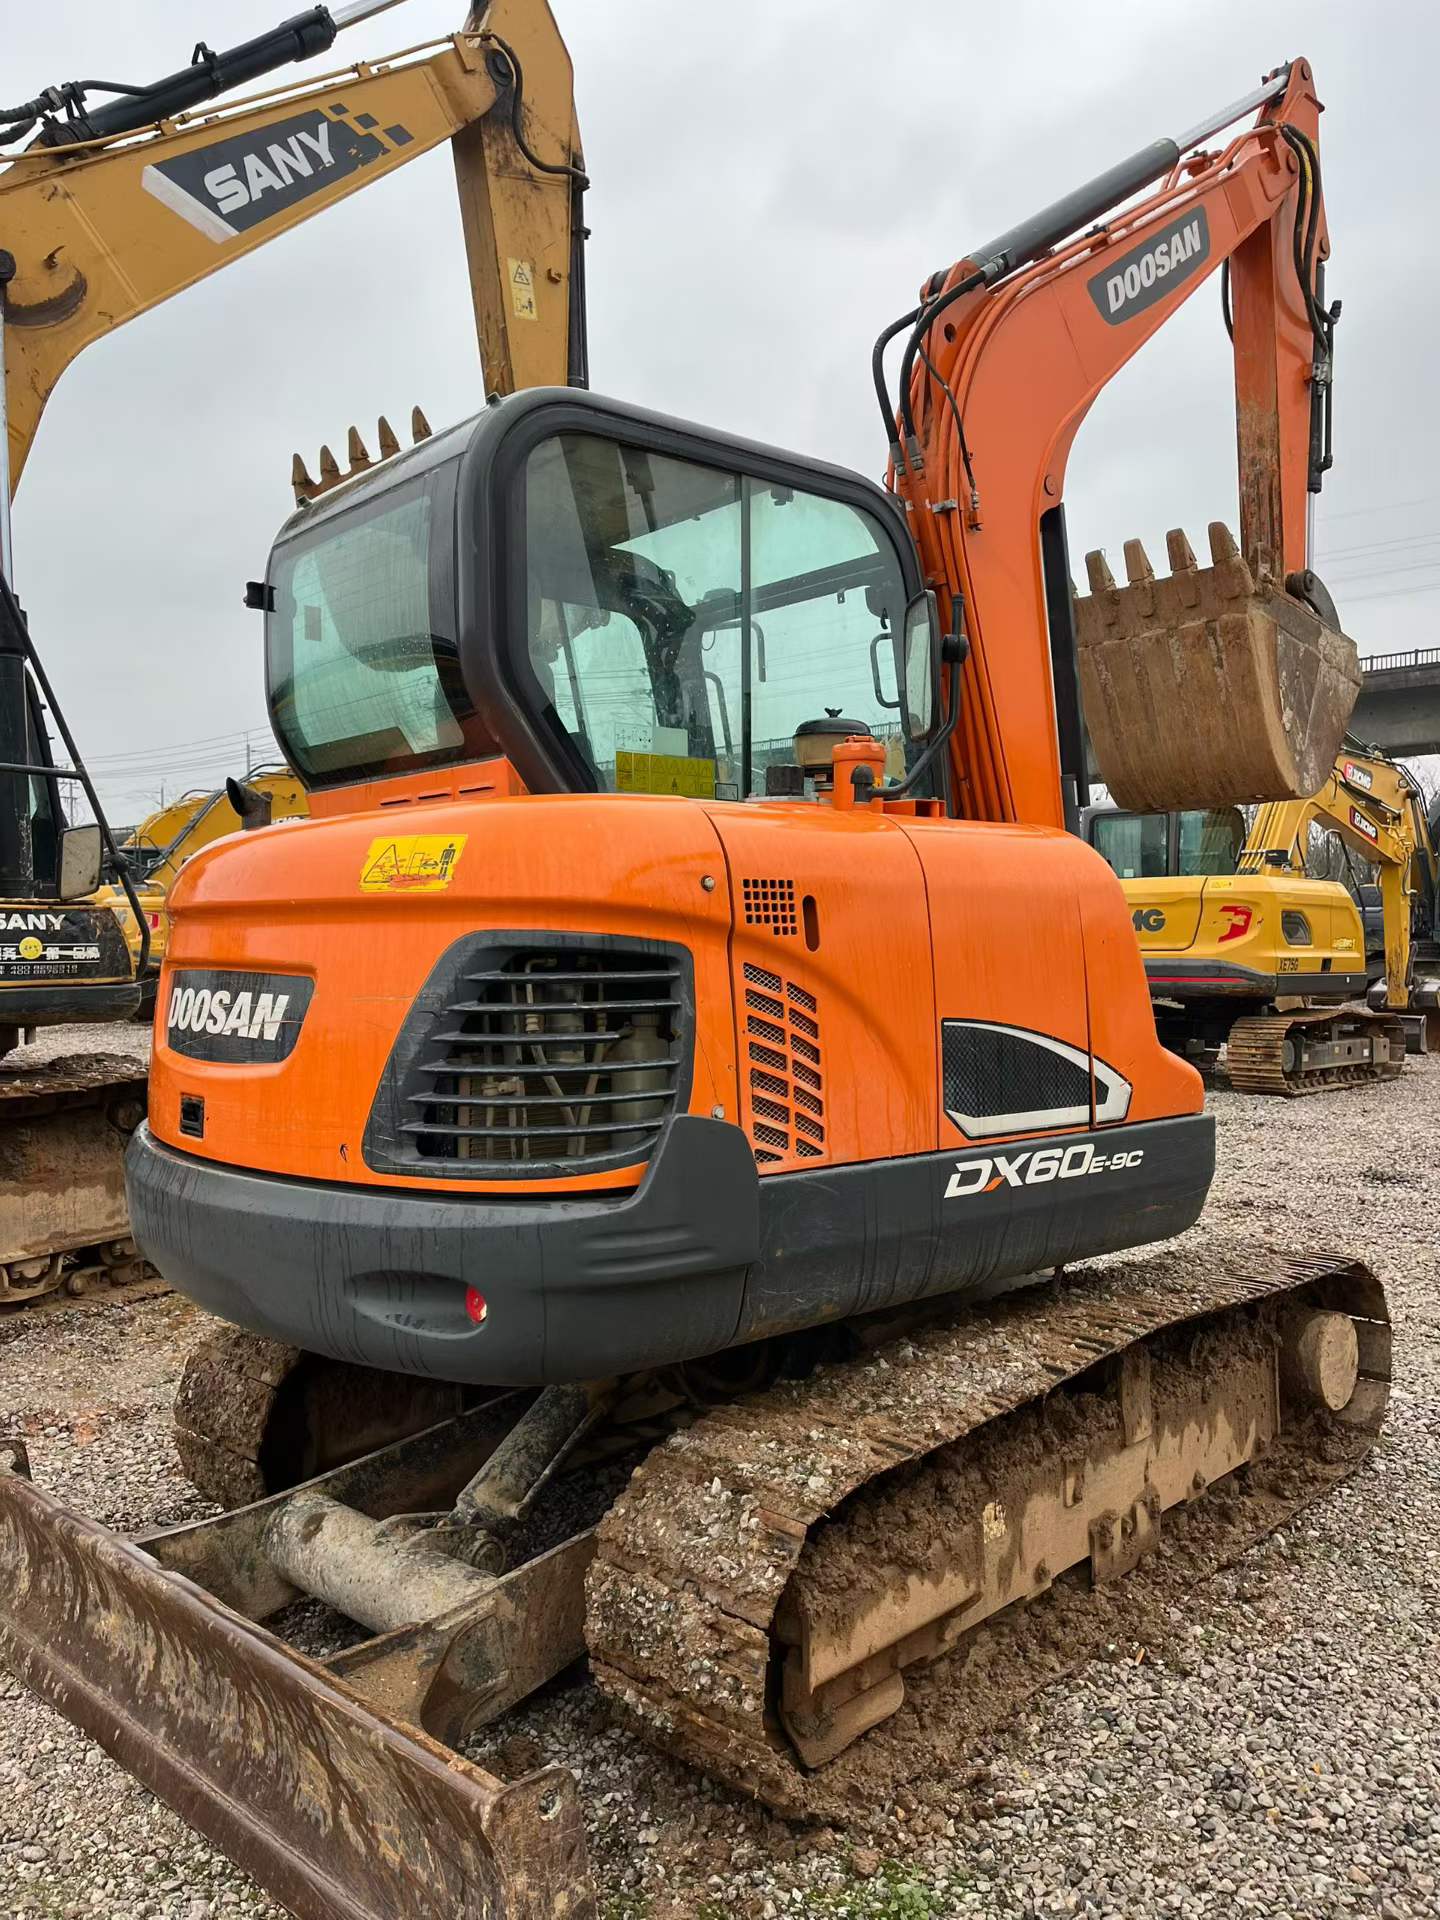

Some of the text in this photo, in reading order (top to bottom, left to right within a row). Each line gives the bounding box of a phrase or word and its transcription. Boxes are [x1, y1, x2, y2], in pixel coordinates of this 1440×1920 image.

[204, 121, 335, 214] SANY
[1106, 219, 1201, 314] DOOSAN
[168, 987, 290, 1041] DOOSAN
